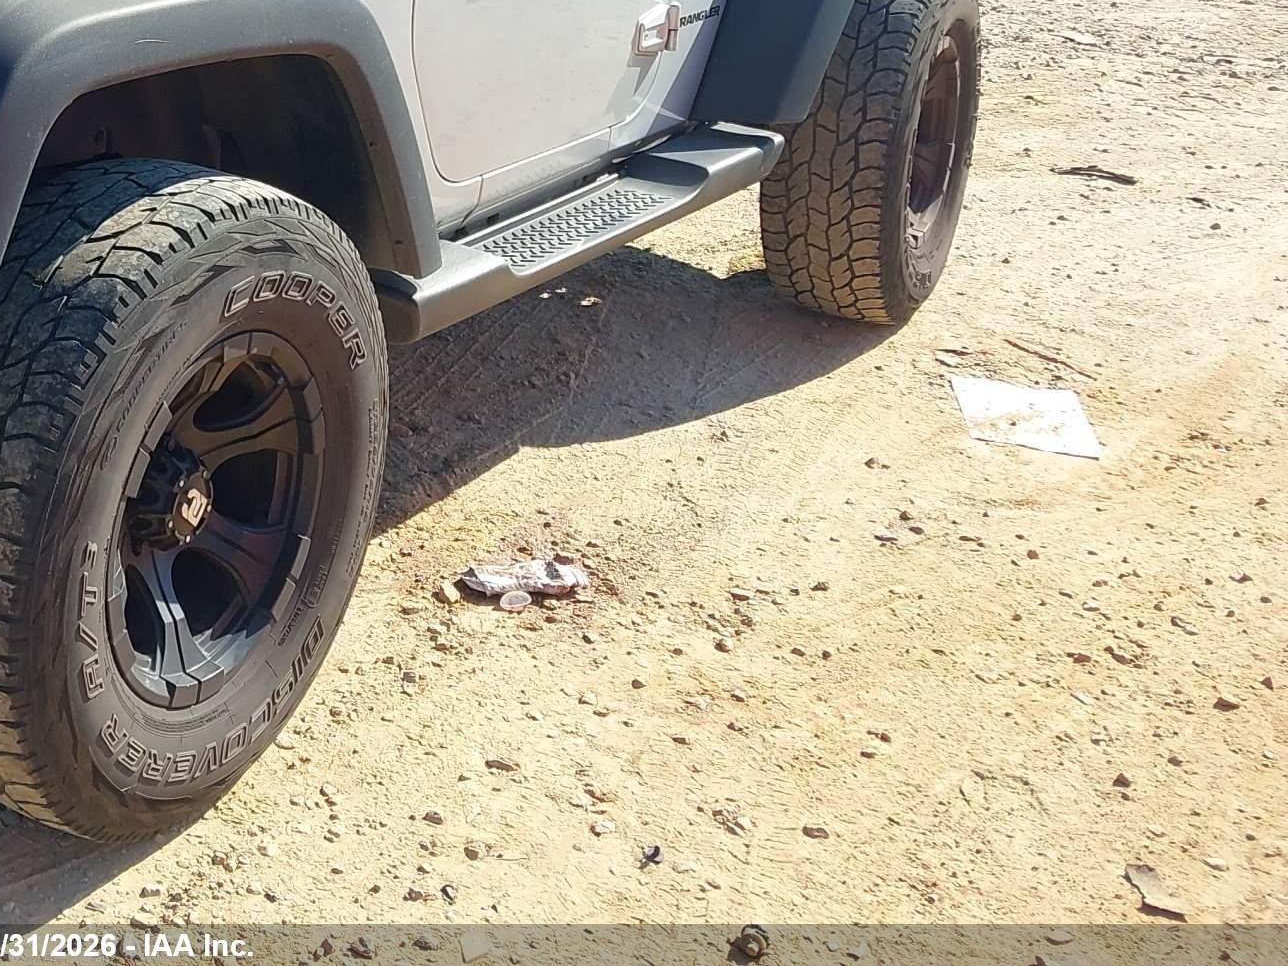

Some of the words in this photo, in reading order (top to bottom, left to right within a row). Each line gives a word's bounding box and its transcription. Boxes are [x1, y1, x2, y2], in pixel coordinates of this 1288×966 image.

[679, 5, 721, 28] RANGLER
[224, 270, 368, 370] COOPER
[101, 614, 325, 781] DISCOVERER
